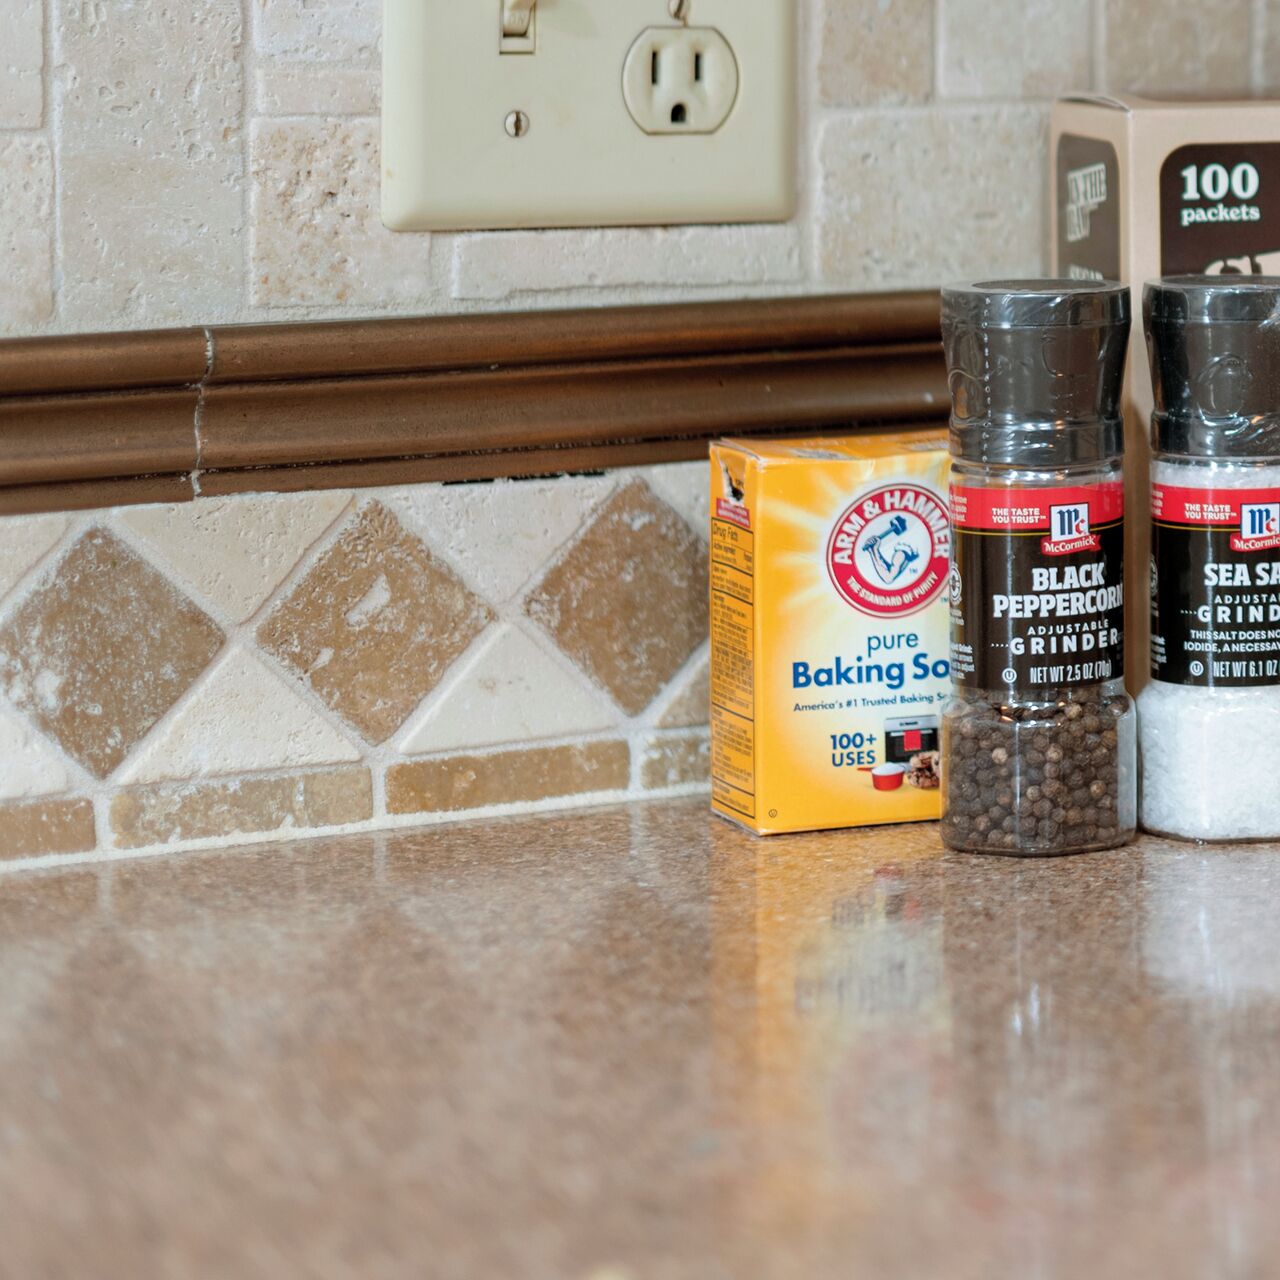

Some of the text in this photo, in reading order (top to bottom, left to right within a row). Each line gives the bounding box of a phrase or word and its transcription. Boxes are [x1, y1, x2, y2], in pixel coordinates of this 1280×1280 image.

[1181, 163, 1260, 200] 100
[1181, 203, 1261, 226] packets
[992, 507, 1041, 516] THE TASTE
[1184, 503, 1231, 513] THE TASTE
[1185, 511, 1201, 520] YOU
[833, 512, 866, 565] ARM
[862, 499, 882, 520] &
[883, 490, 949, 559] HAMMER
[992, 515, 1010, 524] YOU
[1043, 536, 1096, 553] McCormick
[1031, 562, 1106, 592] BLACK
[1204, 563, 1252, 587] SEA
[859, 588, 903, 607] STANDARD
[902, 591, 916, 604] OF
[992, 583, 1124, 618] PEPPERCORN
[1027, 619, 1109, 636] ADJUSTABLE
[1190, 629, 1212, 640] THIS
[1212, 631, 1238, 641] SALT
[1239, 629, 1267, 640] DOES
[867, 632, 919, 658] pure
[1010, 628, 1119, 655] GRINDER
[1183, 641, 1221, 654] IODIDE,
[1222, 642, 1231, 653] A
[792, 656, 905, 690] Baking
[912, 652, 950, 680] So
[1030, 659, 1112, 684] NET WT 2.5 OZ (70g)
[1213, 662, 1231, 678] NET
[1232, 661, 1248, 678] WT
[1249, 661, 1263, 677] 6.1
[1266, 660, 1278, 676] OZ
[793, 699, 843, 712] America's
[846, 698, 858, 708] #1
[861, 695, 897, 708] Trusted
[900, 690, 934, 705] Baking
[830, 732, 877, 750] 100+
[831, 750, 876, 768] USES
